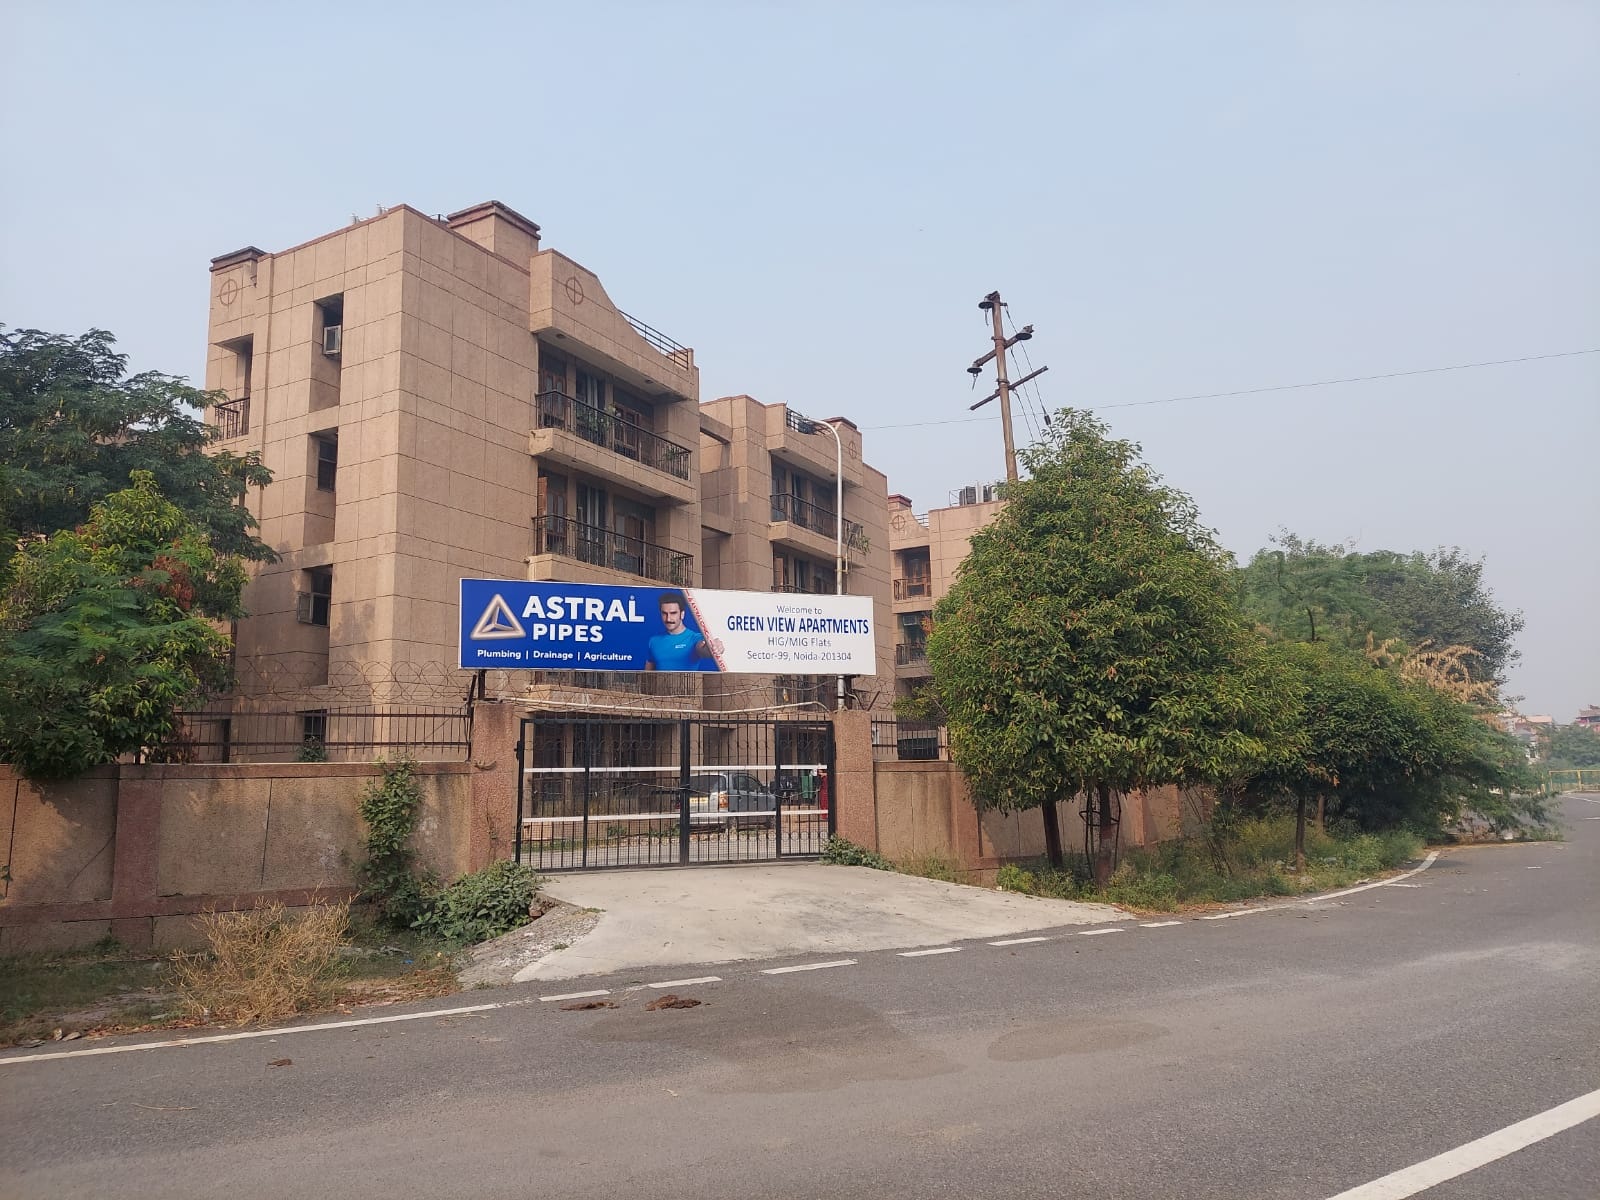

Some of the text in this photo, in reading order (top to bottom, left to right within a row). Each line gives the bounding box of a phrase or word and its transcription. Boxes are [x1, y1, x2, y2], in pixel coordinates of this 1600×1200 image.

[522, 596, 645, 623] ASTRAL
[776, 605, 823, 615] Welcome to
[727, 615, 764, 631] GREEN
[767, 617, 796, 633] VIEW
[799, 618, 869, 635] APARTMENTS
[533, 623, 604, 643] PIPES
[768, 637, 832, 647] HIG/MIG Flats
[477, 649, 633, 661] Plumbing Drainage Agriculture
[747, 650, 791, 661] Sector-99,
